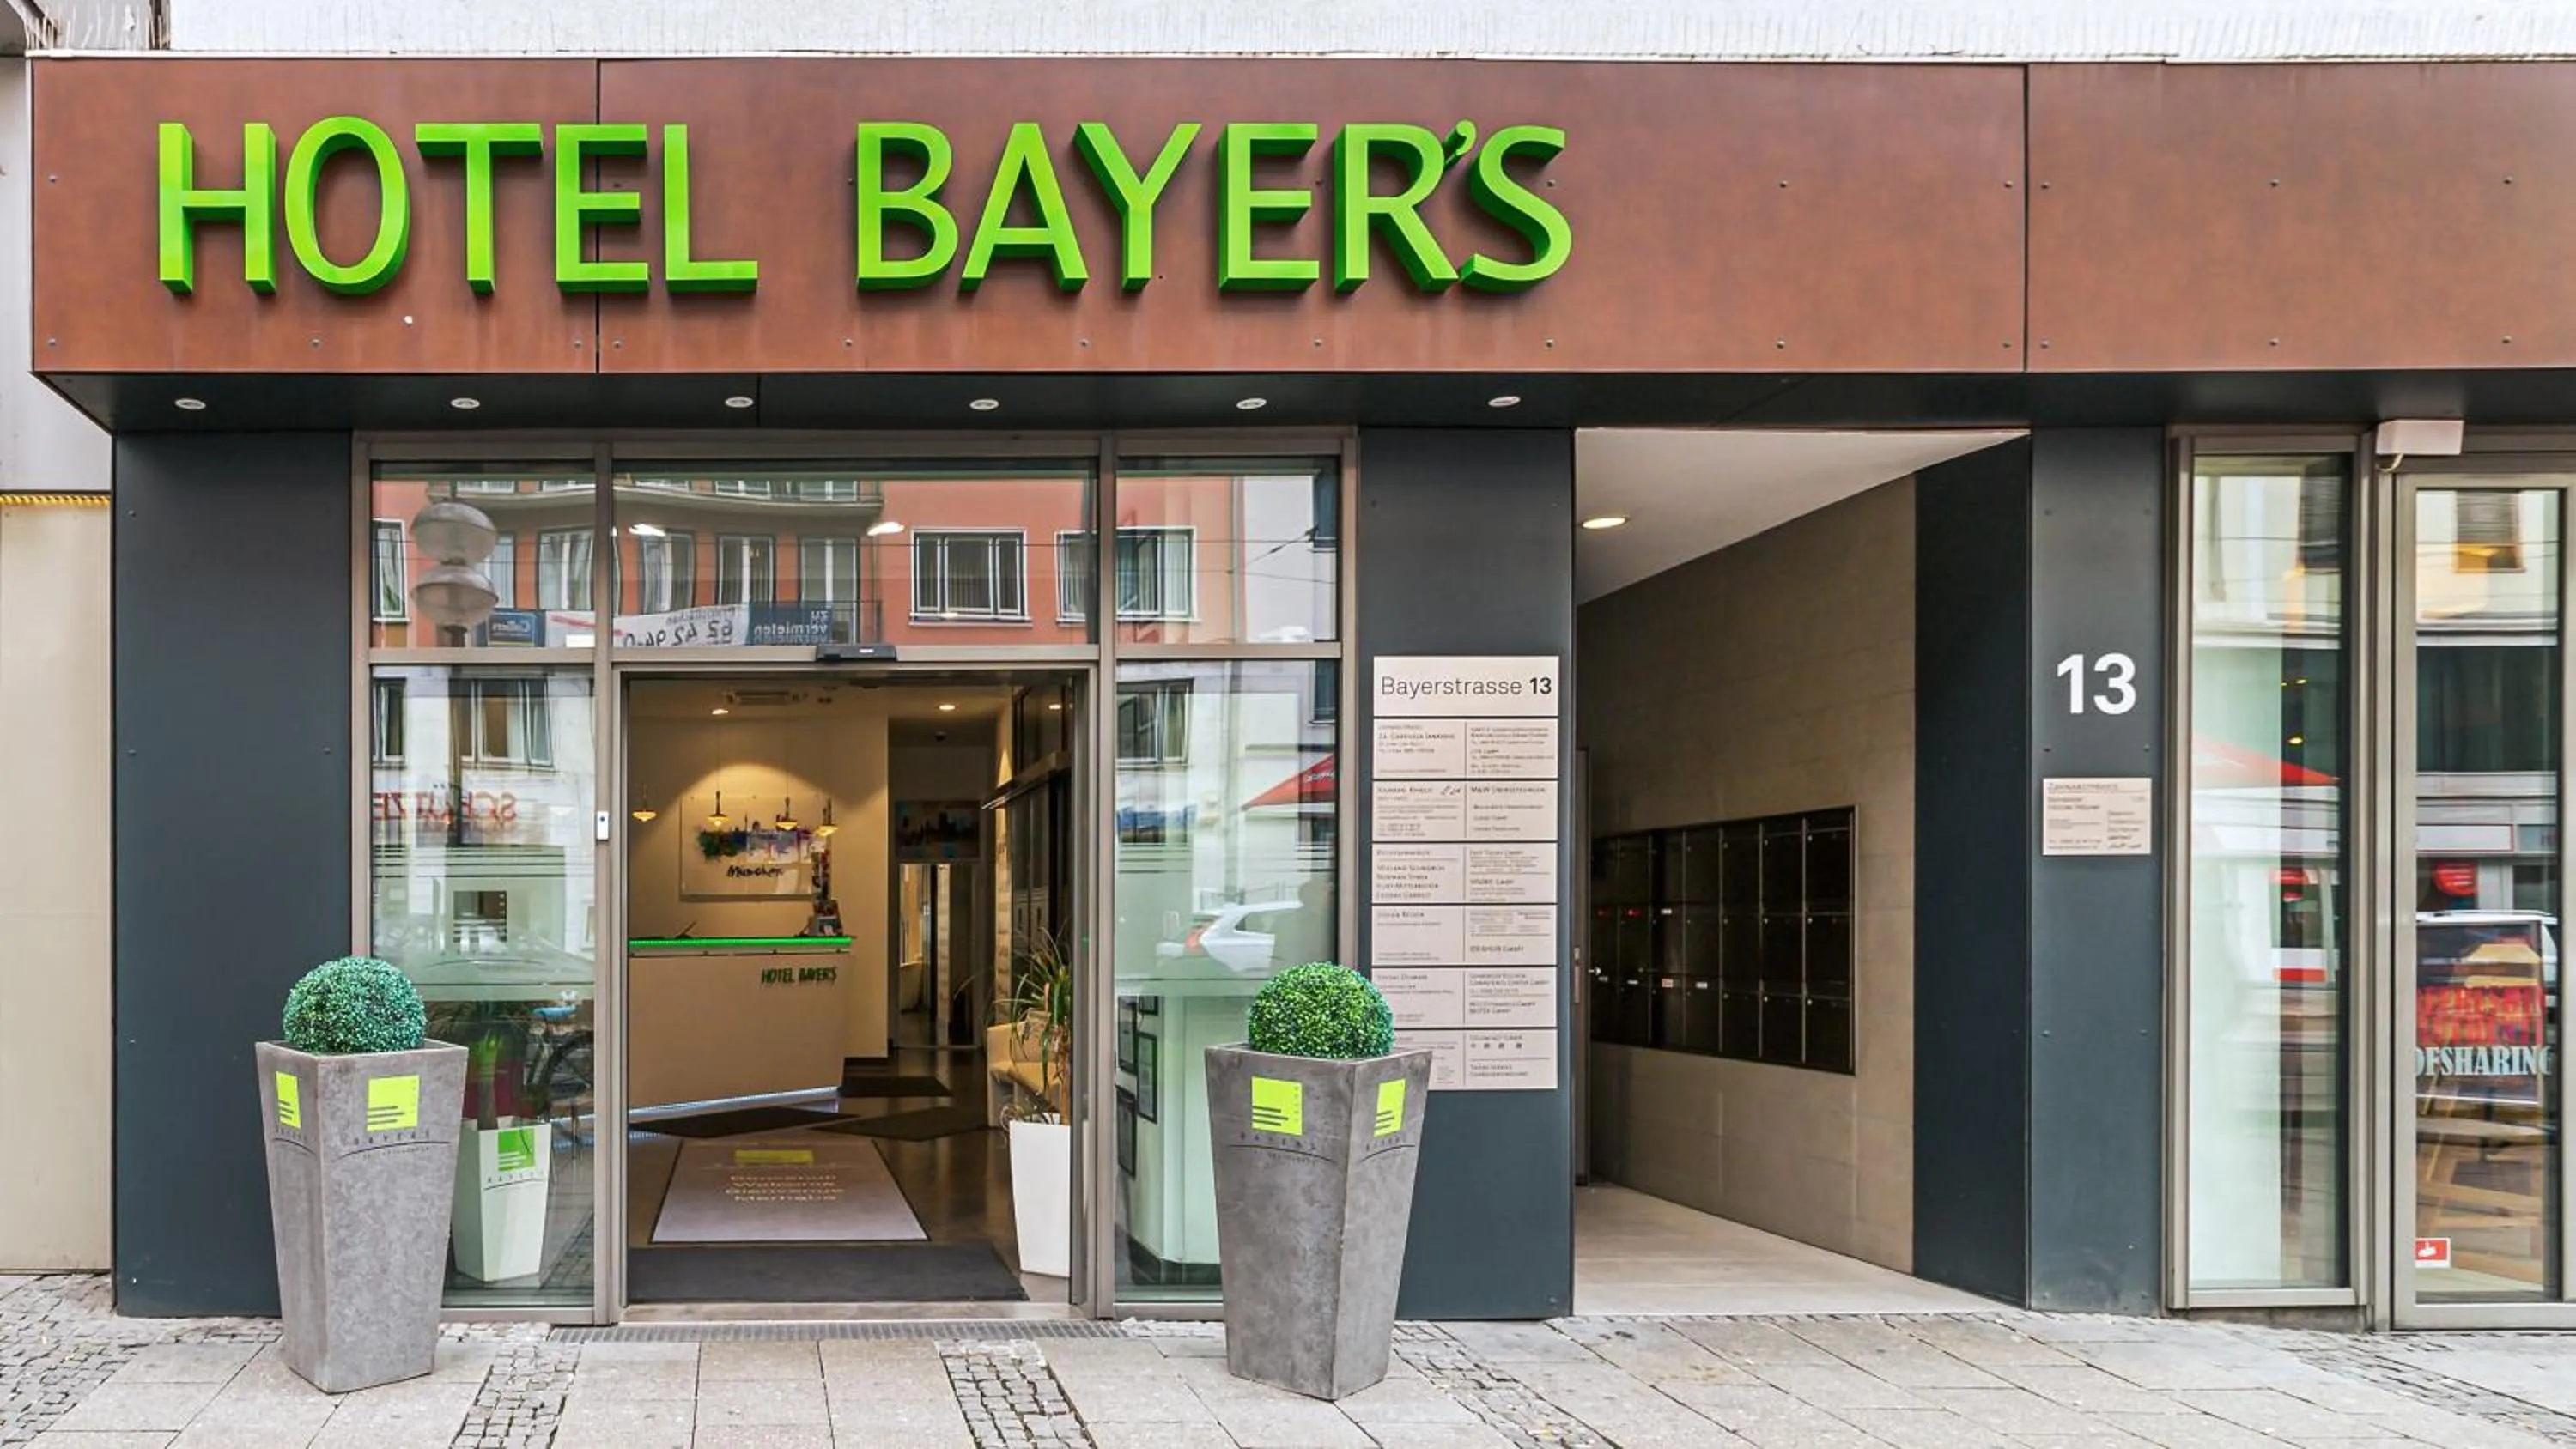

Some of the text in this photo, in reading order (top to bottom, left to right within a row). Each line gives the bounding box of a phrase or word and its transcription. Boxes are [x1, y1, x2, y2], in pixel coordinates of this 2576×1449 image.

[159, 116, 1572, 295] HOTEL BAYER'S
[1381, 676, 1552, 700] Bayerstrasse 13
[2057, 652, 2137, 715] 13
